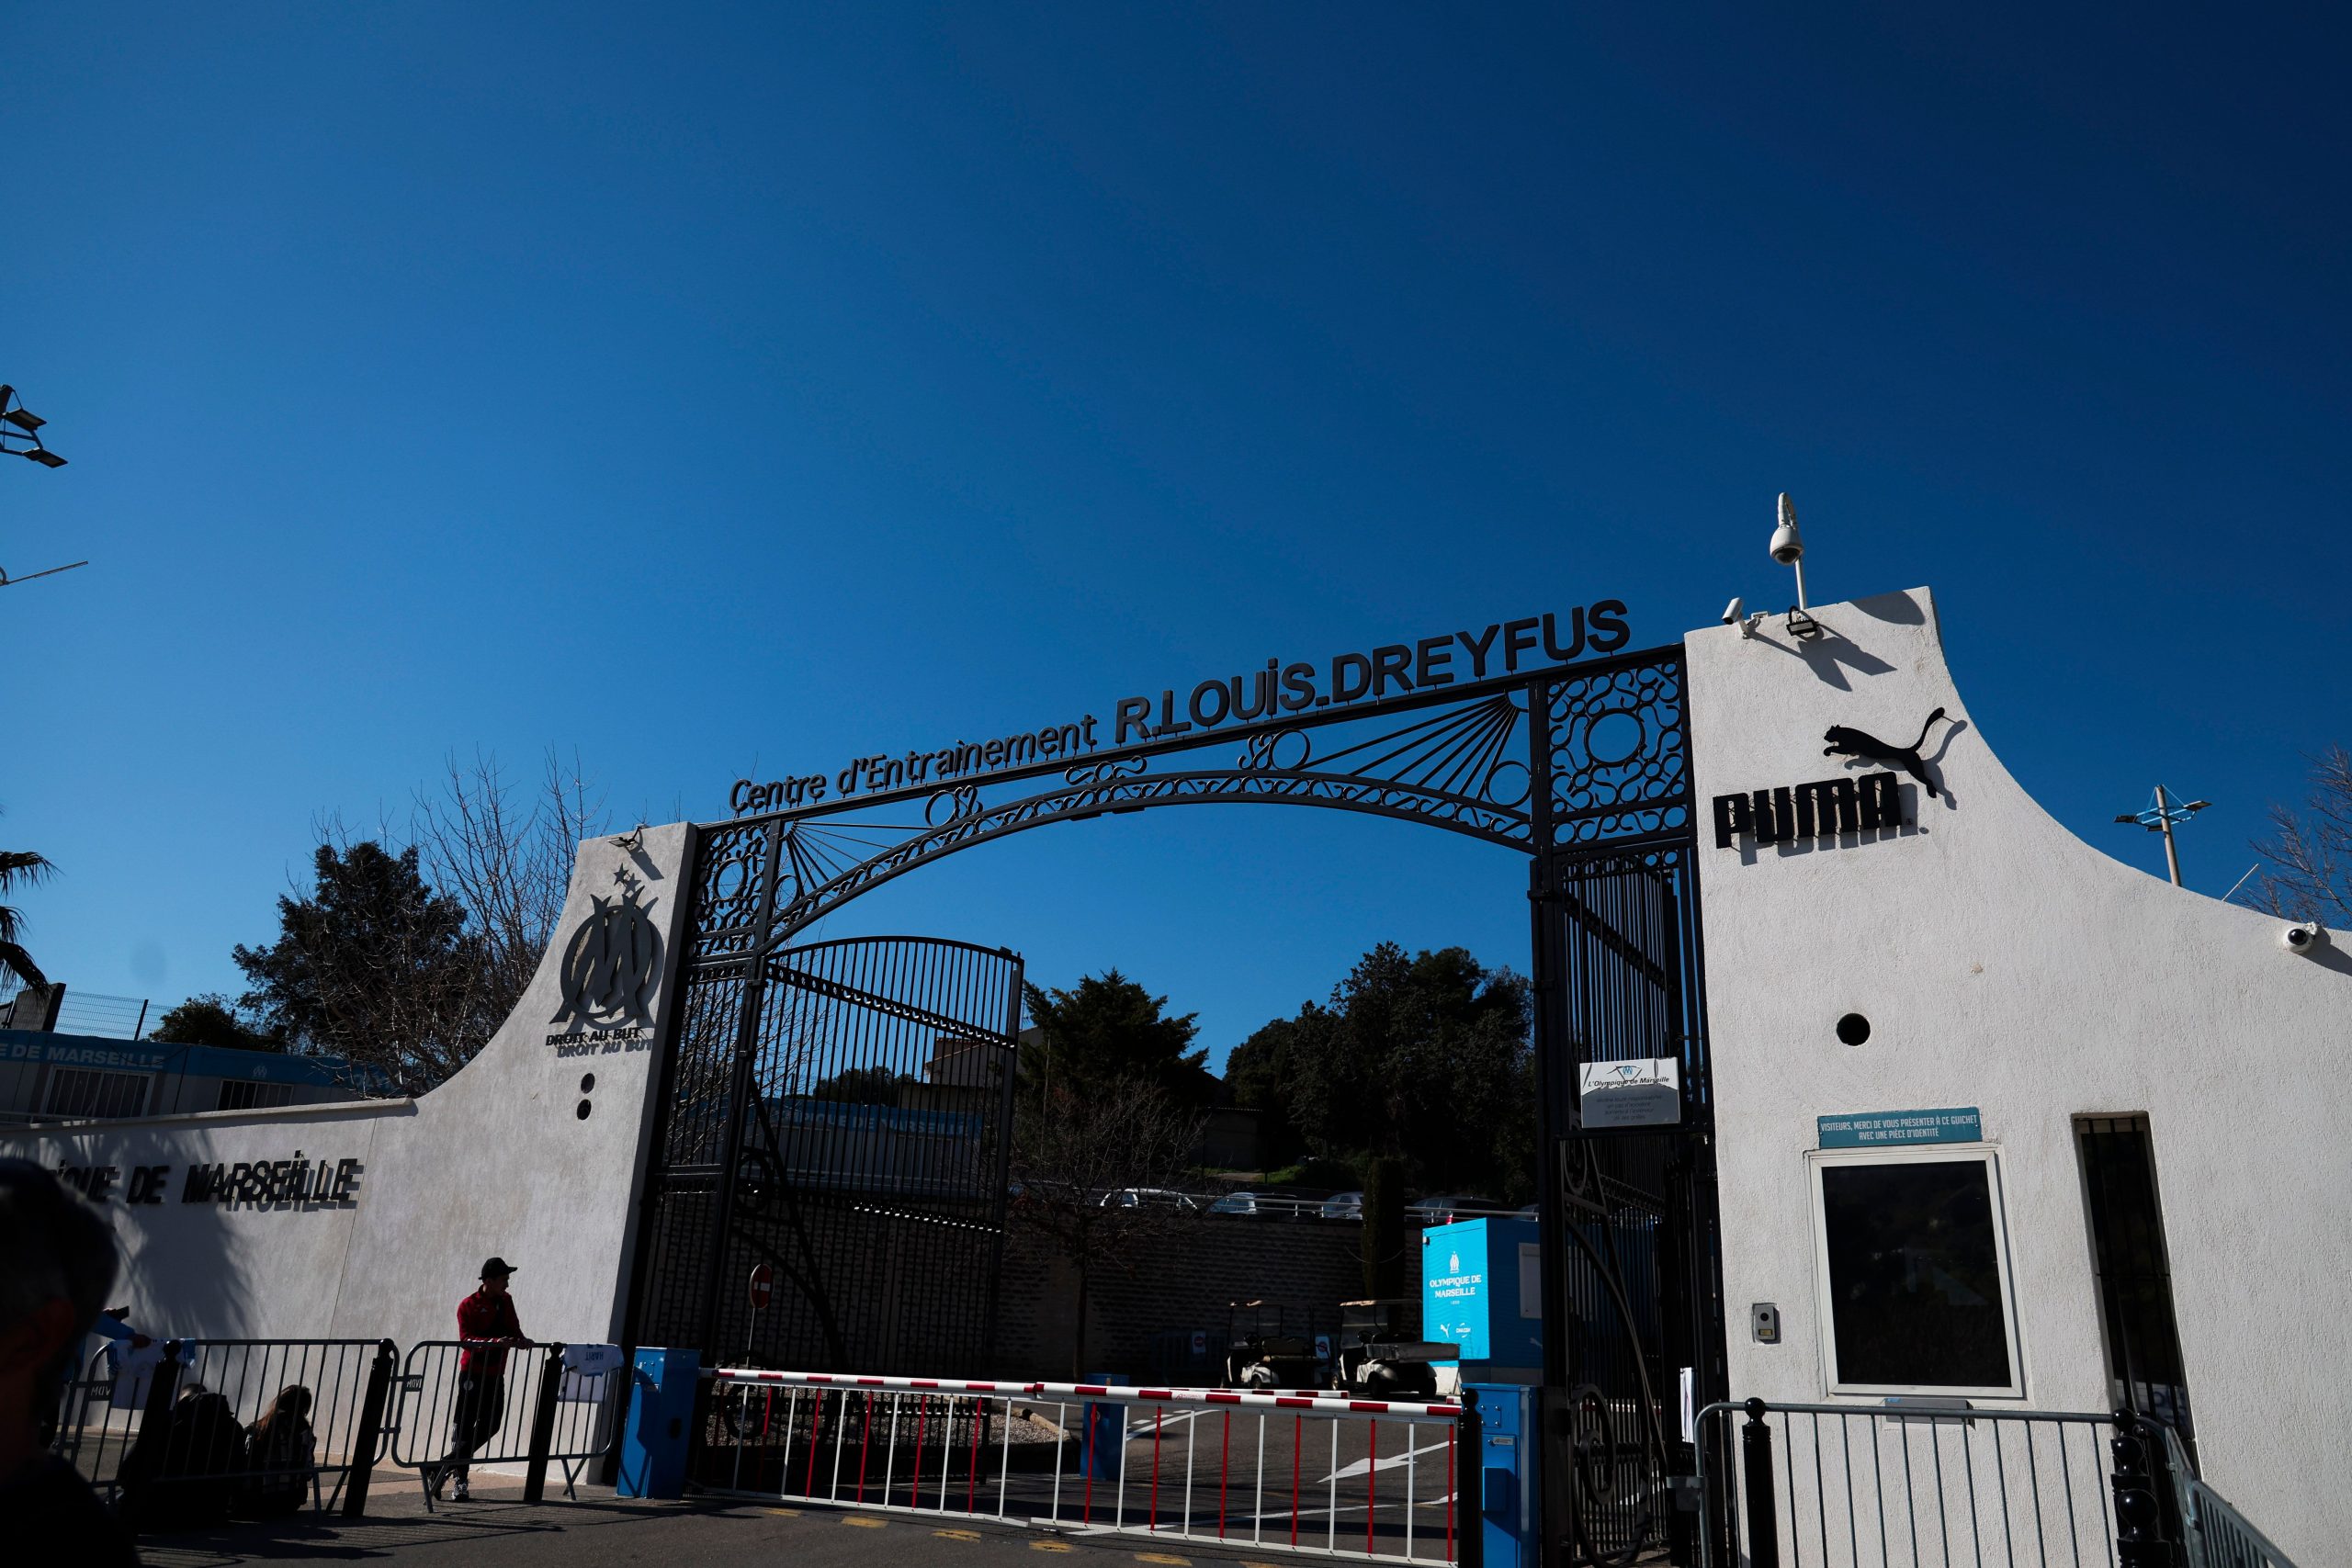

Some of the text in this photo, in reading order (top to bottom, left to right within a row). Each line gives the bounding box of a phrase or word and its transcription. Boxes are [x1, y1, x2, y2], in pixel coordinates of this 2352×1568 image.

[729, 773, 826, 814] Centre
[1713, 771, 1903, 849] PUMA
[11, 1043, 41, 1059] DE
[46, 1047, 165, 1069] MARSEILLE
[1820, 1121, 1853, 1132] VISITEURS,
[1854, 1121, 1872, 1130] MERCI
[1873, 1120, 1882, 1129] DE
[1883, 1119, 1899, 1128] VOUS
[1901, 1116, 1935, 1127] PRÉSENTER
[1941, 1116, 1950, 1124] CE
[1951, 1114, 1977, 1124] GUICHET
[1859, 1131, 1874, 1140] AVEC
[1875, 1131, 1887, 1139] UNE
[1907, 1127, 1939, 1138] D'IDENTITÉ
[126, 1165, 170, 1203] DE
[1430, 1274, 1482, 1288] OLYMPIQUE DE
[1434, 1287, 1476, 1298] MARSEILLE
[585, 1351, 604, 1360] HARIT
